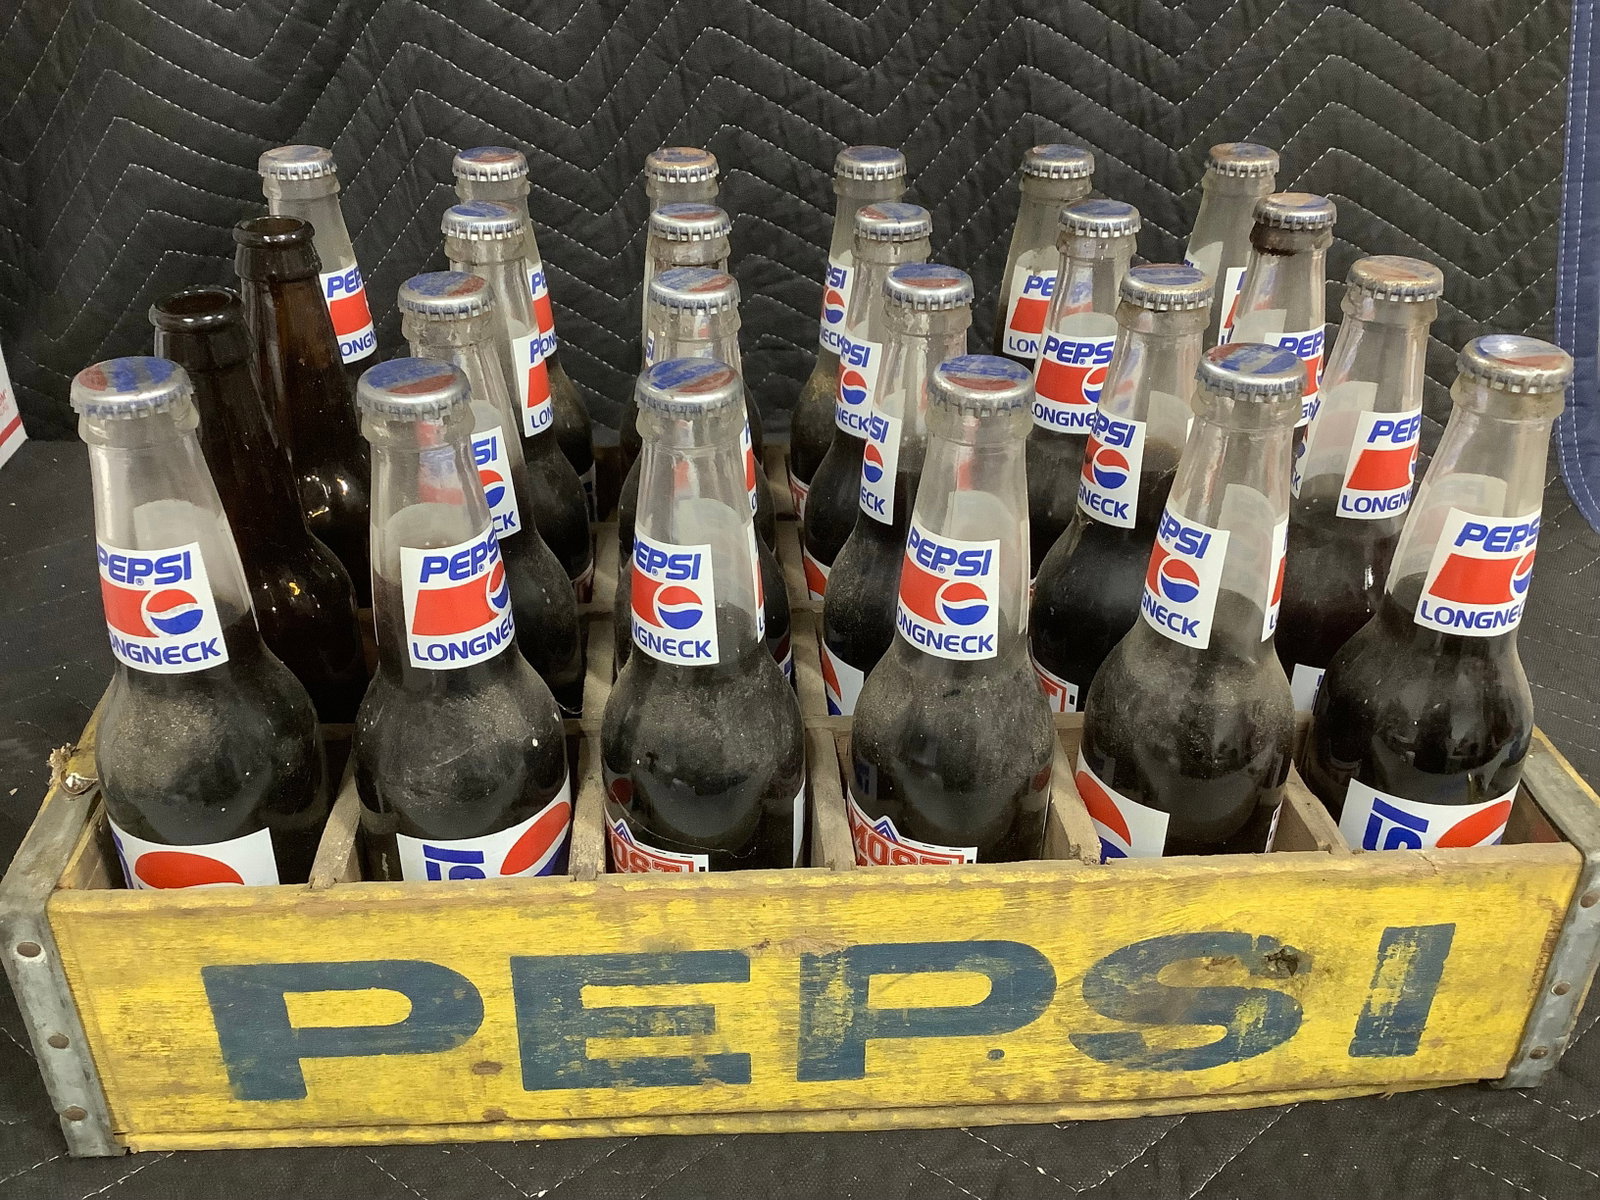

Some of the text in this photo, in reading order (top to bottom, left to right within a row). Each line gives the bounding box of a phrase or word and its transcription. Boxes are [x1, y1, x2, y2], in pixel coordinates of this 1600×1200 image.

[1279, 331, 1325, 358] PEP
[1091, 408, 1136, 448] PSI
[1341, 487, 1413, 513] LONGN
[97, 543, 192, 585] PEPSI
[907, 526, 992, 576] PEPSI
[201, 923, 1456, 1102] PEPSI
